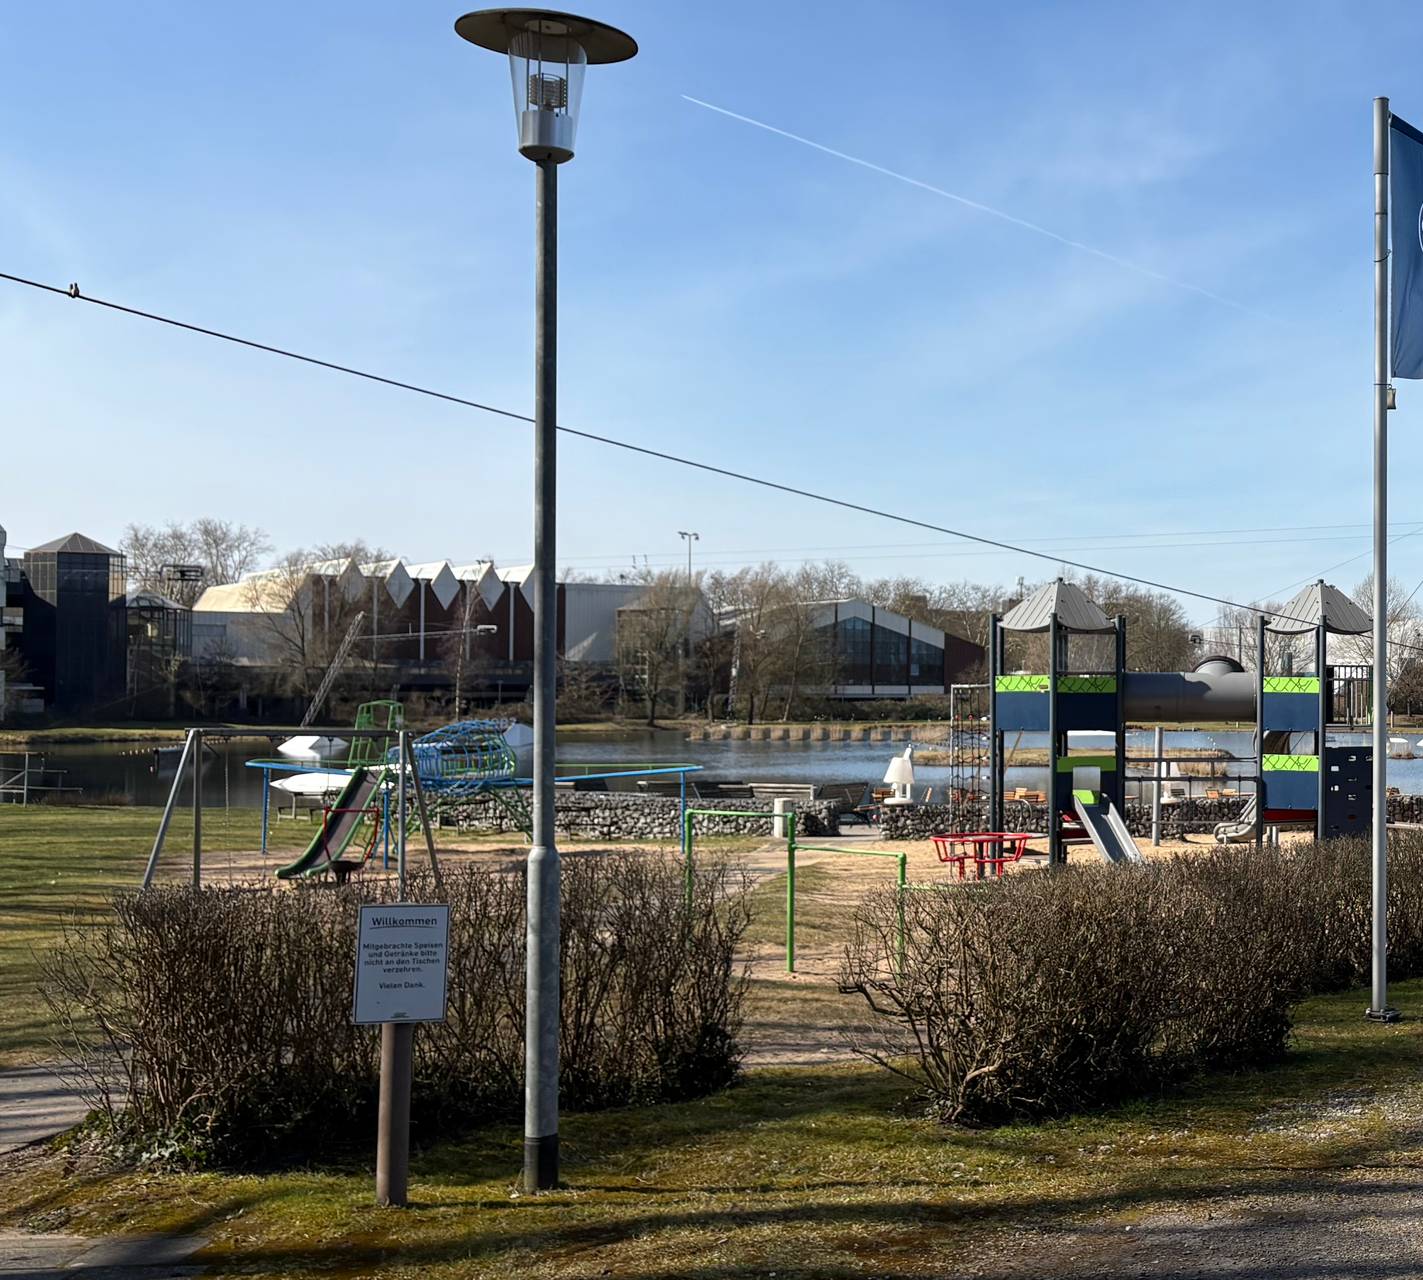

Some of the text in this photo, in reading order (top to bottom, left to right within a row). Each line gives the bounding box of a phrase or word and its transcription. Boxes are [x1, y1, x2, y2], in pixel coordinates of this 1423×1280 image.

[371, 917, 438, 926] Willkommen
[363, 942, 443, 951] Mitgebrachte Speisen
[384, 950, 419, 958] Getränke
